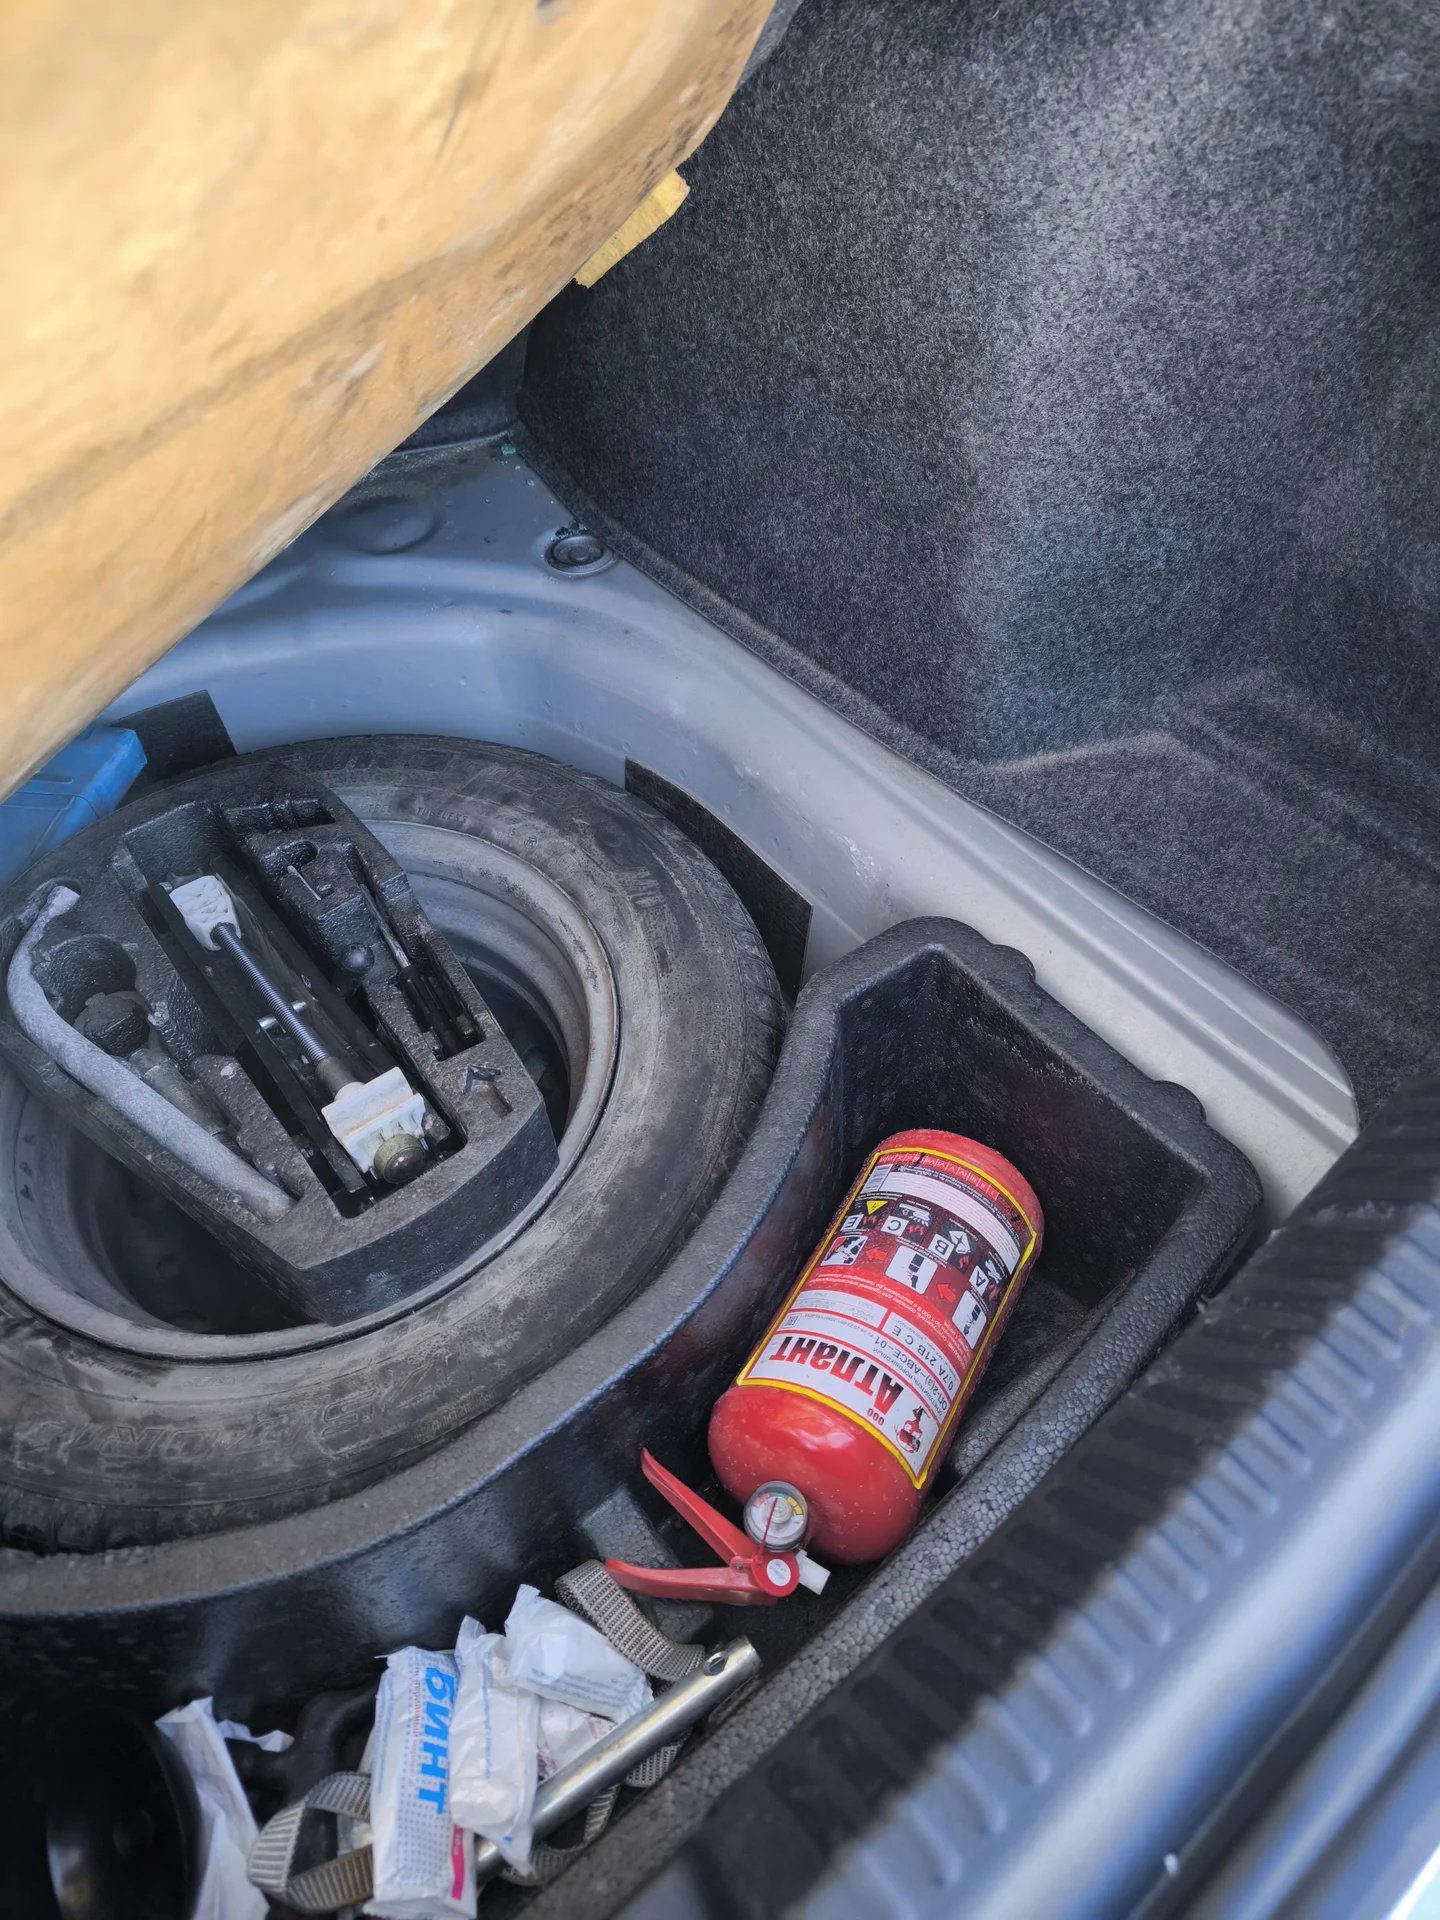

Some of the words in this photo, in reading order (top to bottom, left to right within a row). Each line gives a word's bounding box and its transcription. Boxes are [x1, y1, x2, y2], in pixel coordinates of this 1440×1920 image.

[768, 1335, 905, 1416] Атлант
[872, 1348, 913, 1380] ПОРОШКОВЫЙ
[865, 1407, 886, 1427] ООО
[912, 1377, 943, 1417] ОГНЕТУШИТЕЛЬ
[416, 1667, 455, 1814] БИНТ
